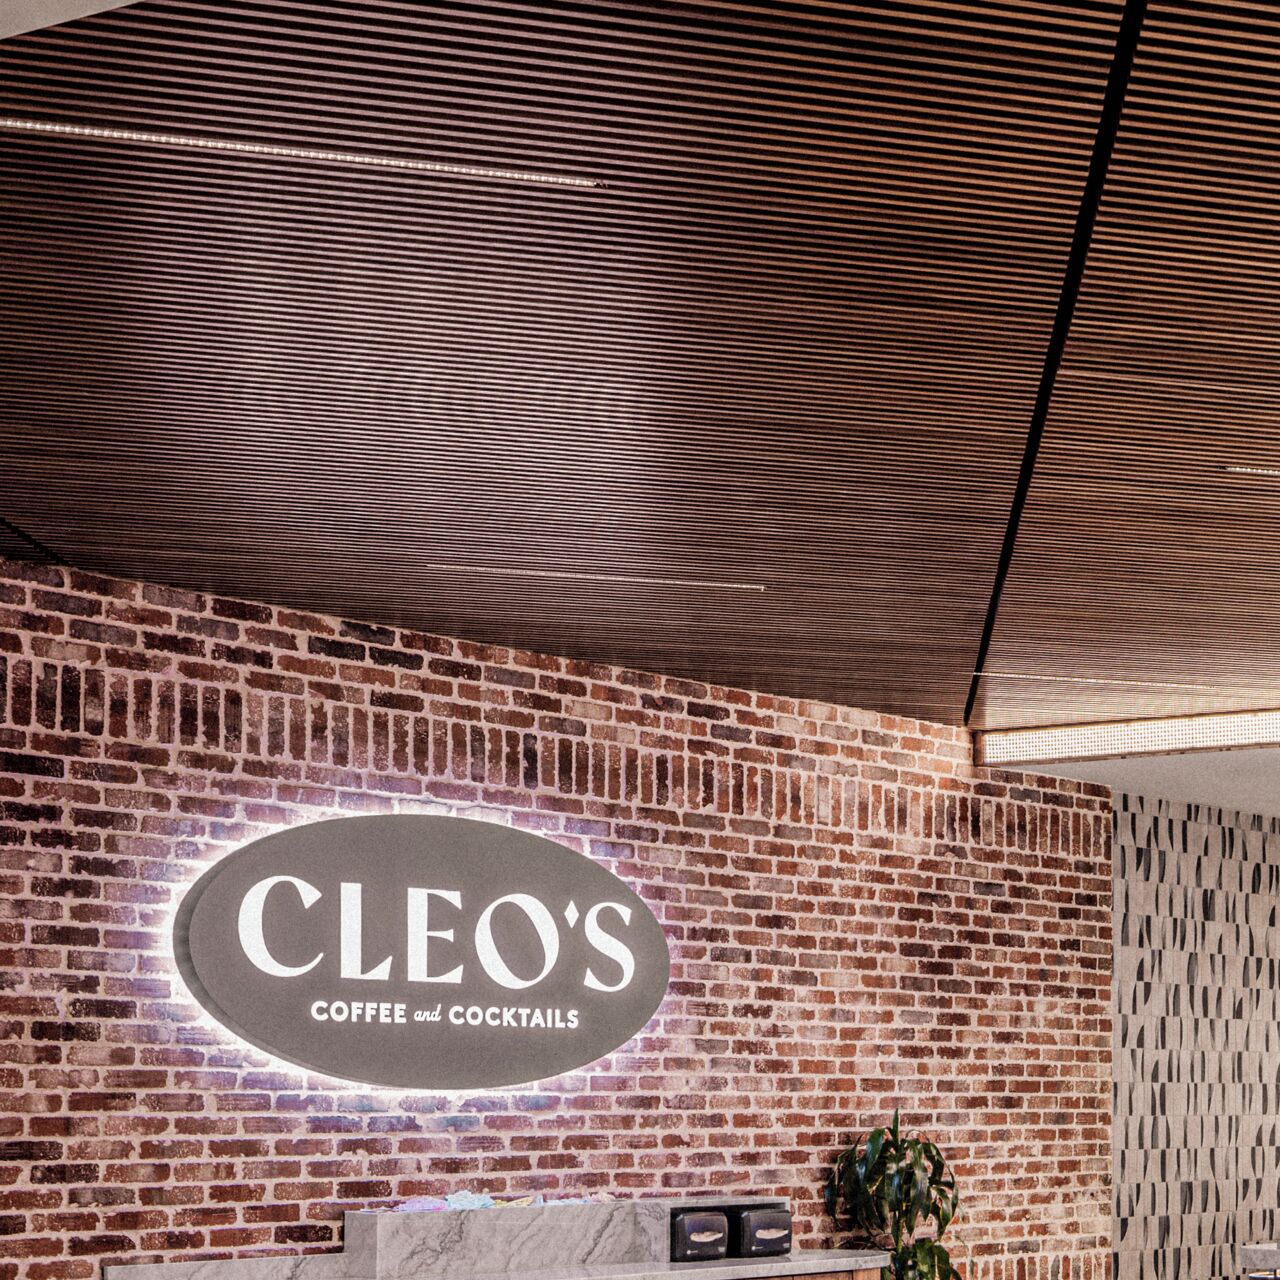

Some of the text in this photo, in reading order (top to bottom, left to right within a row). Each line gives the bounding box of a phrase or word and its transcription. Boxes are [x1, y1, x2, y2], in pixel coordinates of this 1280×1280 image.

[237, 874, 637, 993] CLEO'S
[310, 1000, 580, 1030] COFFEE and COCKTAILS
